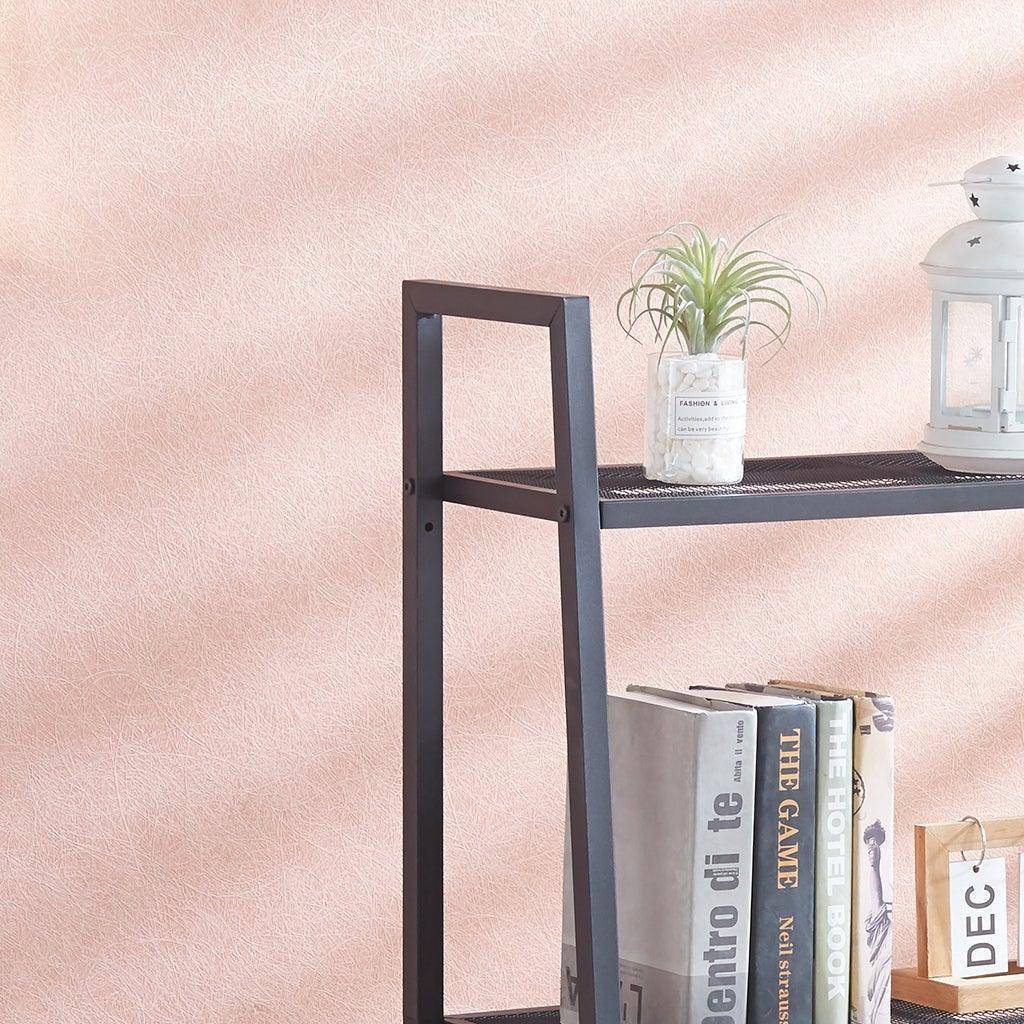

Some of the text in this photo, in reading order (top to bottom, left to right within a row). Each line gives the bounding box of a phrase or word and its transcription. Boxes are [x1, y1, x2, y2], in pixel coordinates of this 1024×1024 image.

[735, 720, 745, 744] vento
[707, 792, 744, 833] te
[777, 727, 801, 890] THE GAME
[703, 853, 740, 891] di
[826, 712, 848, 1001] THE HOTEL BOOK
[778, 916, 795, 955] Neil
[964, 883, 996, 968] DEC
